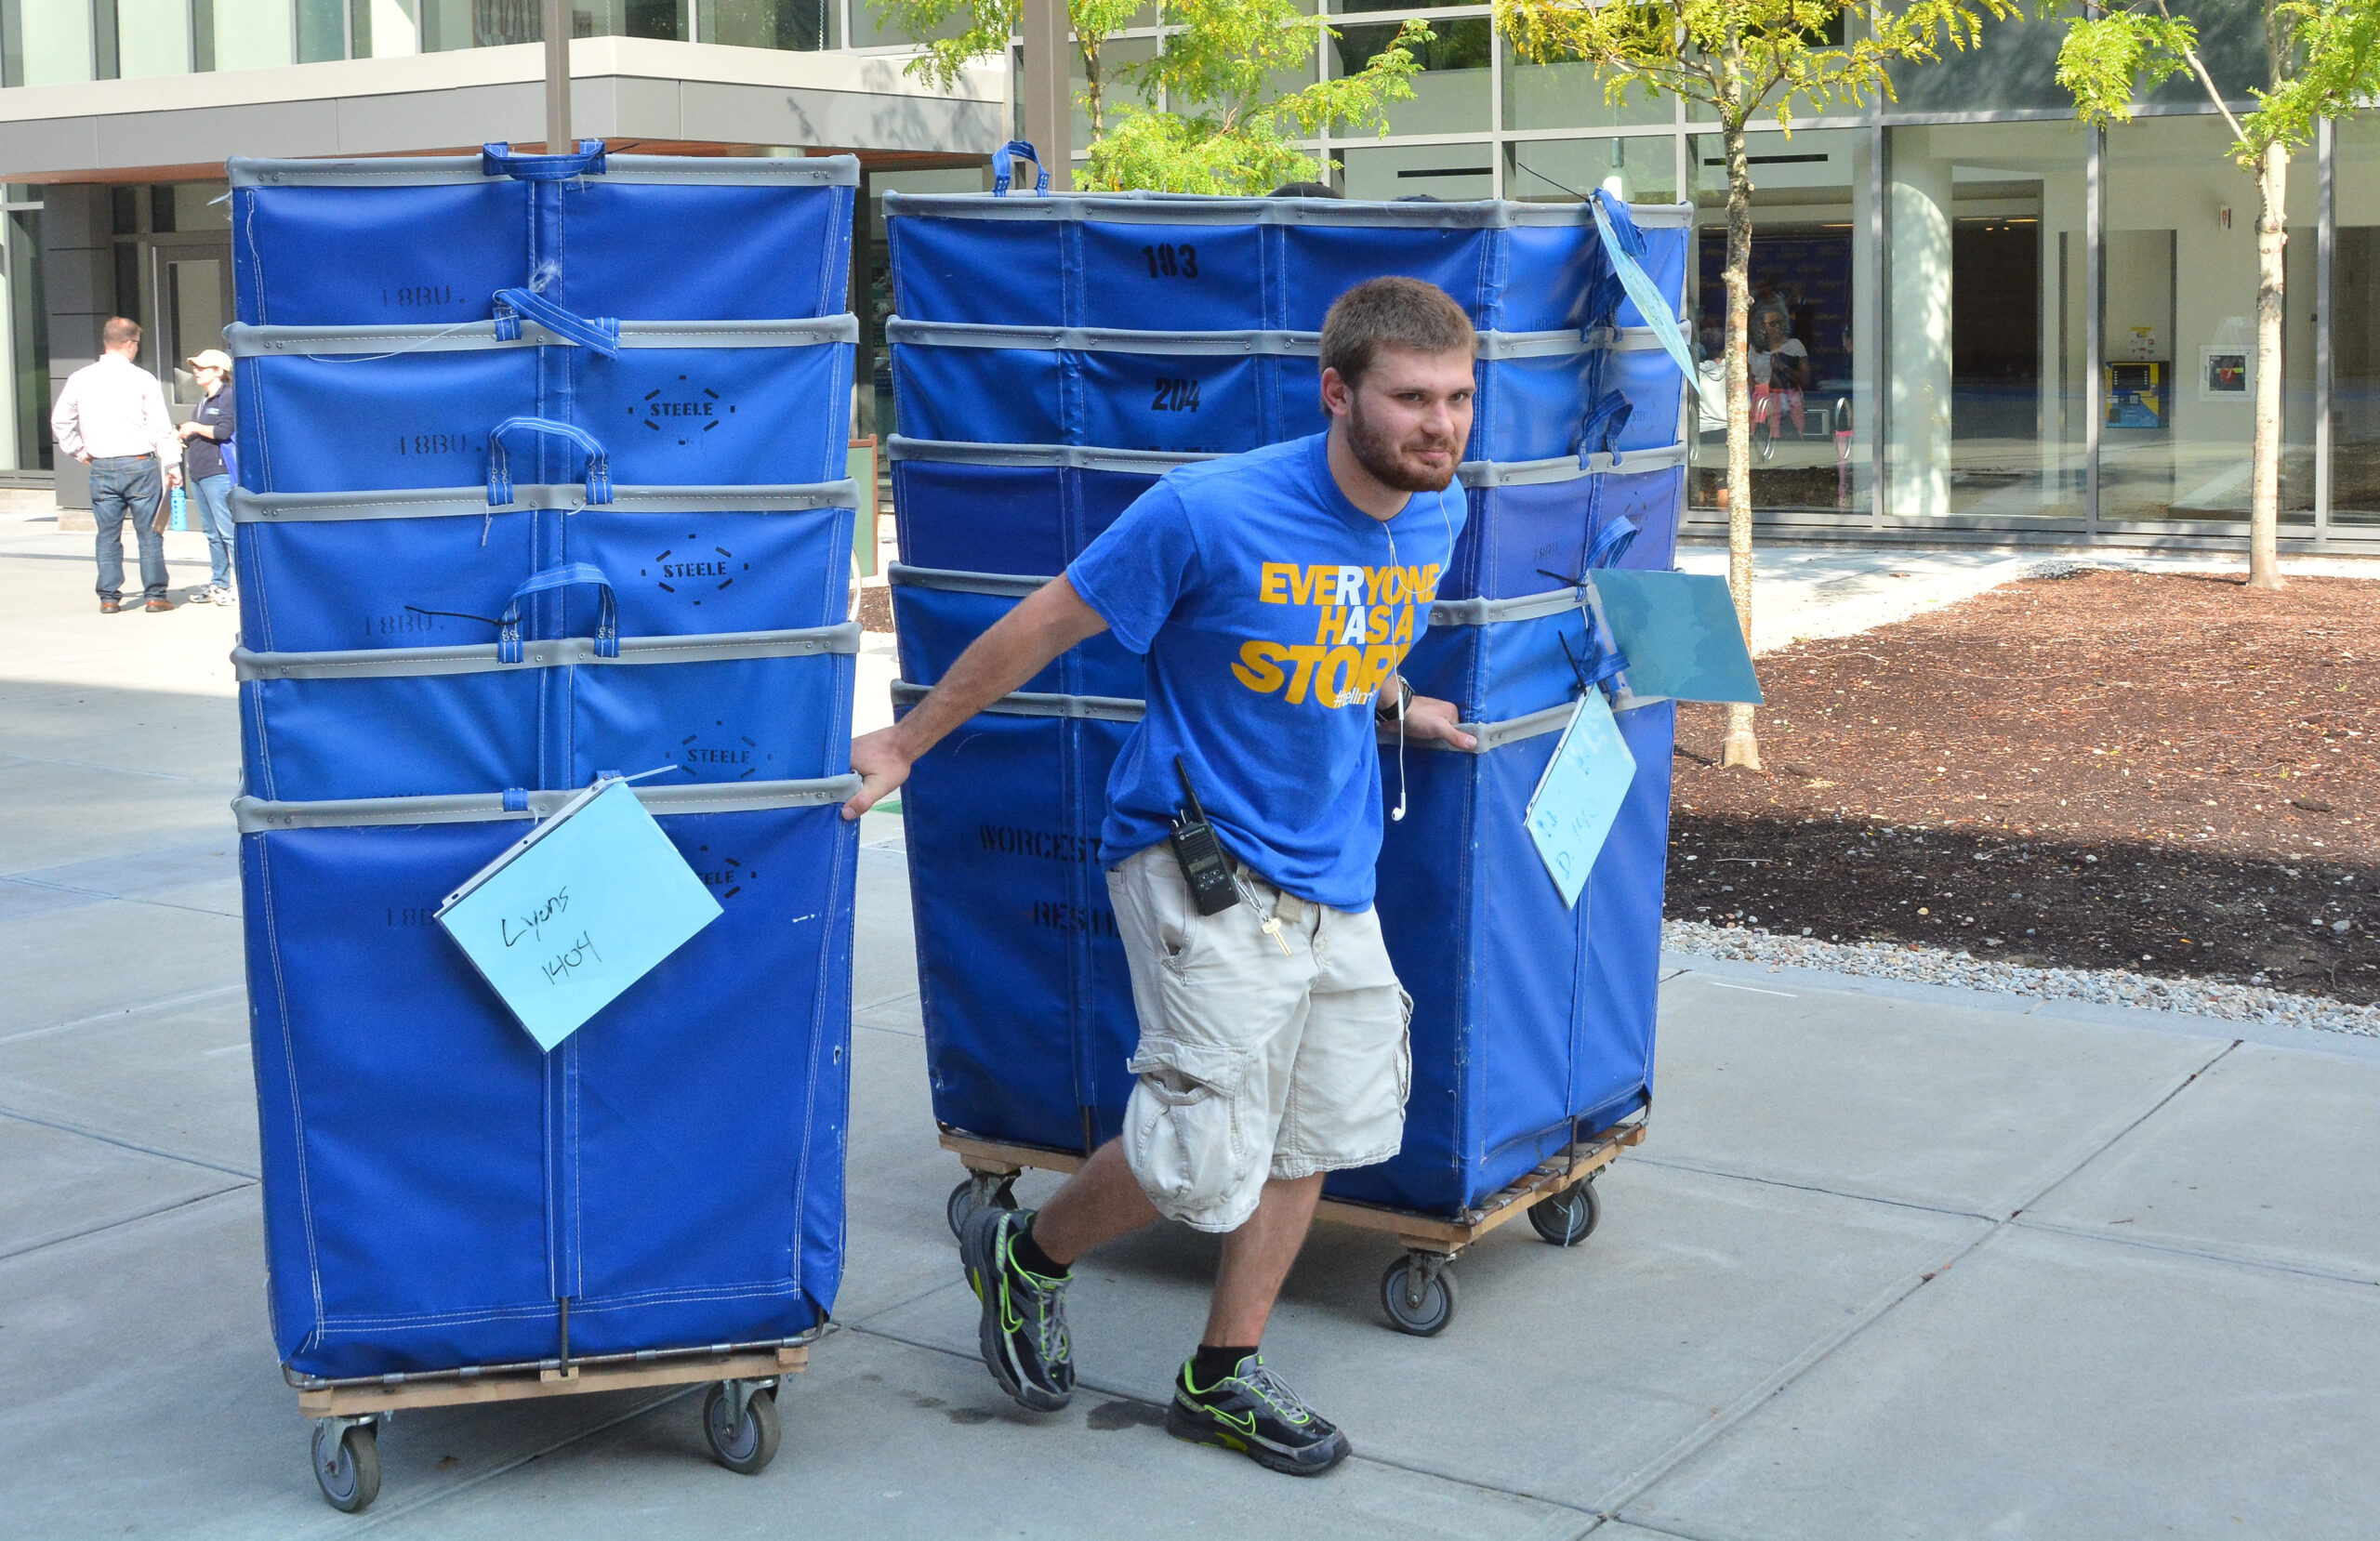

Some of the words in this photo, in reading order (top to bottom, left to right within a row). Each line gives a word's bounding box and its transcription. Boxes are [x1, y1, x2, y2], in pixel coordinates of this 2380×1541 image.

[1142, 243, 1199, 279] 183
[650, 401, 714, 417] STEELE
[1151, 376, 1201, 413] 204
[663, 560, 727, 578] STEELE
[1259, 561, 1440, 606] EVERYONE
[1315, 605, 1392, 645] HAS
[1394, 604, 1415, 642] A
[1230, 639, 1412, 710] STOR
[687, 748, 750, 764] STEELE
[979, 824, 1103, 865] WORCEST
[501, 885, 569, 947] Lyons
[1033, 900, 1122, 938] RESI
[541, 929, 602, 986] 1404
